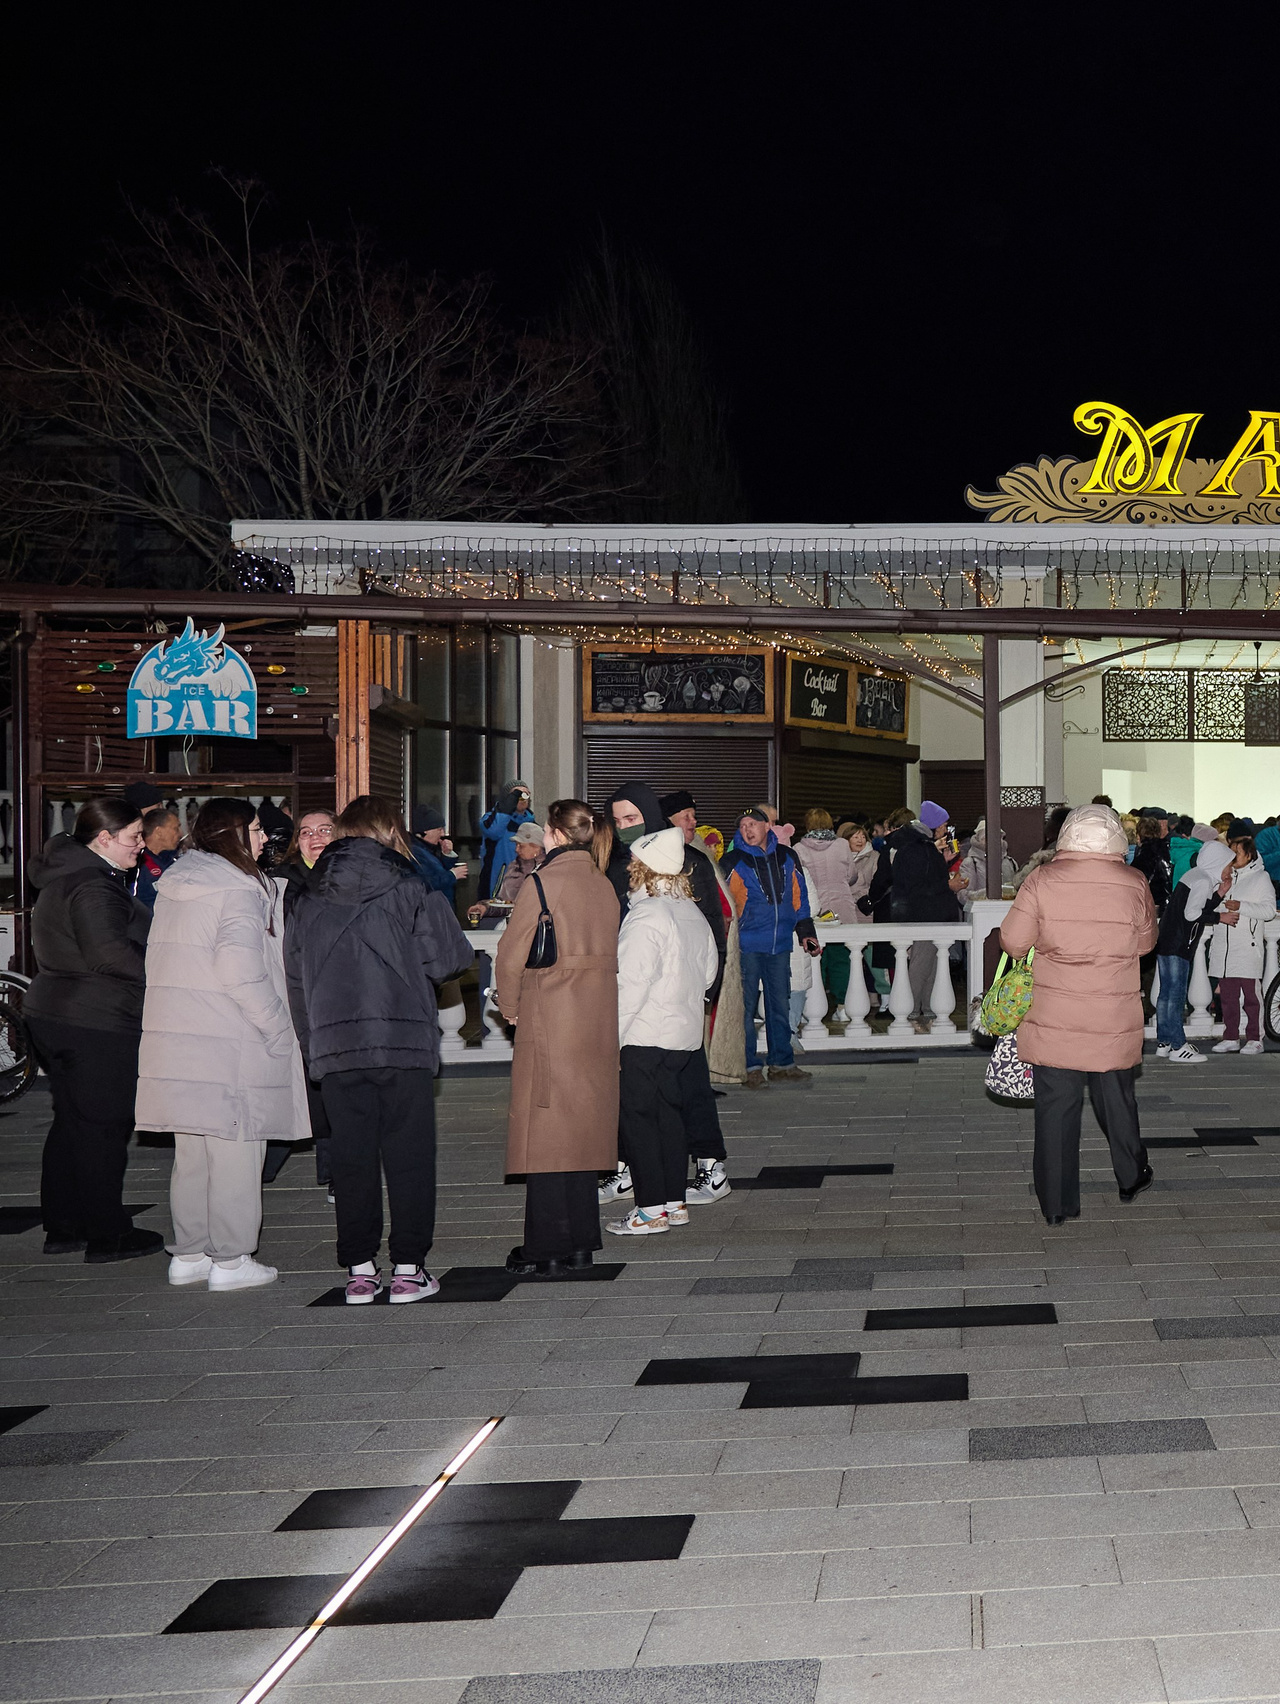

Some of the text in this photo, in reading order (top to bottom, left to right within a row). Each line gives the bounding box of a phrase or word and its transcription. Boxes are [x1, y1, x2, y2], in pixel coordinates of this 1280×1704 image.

[184, 687, 206, 696] ICE
[804, 667, 840, 694] Cocktail
[811, 697, 828, 718] Bar
[863, 677, 900, 712] BEER
[134, 699, 251, 734] BAR
